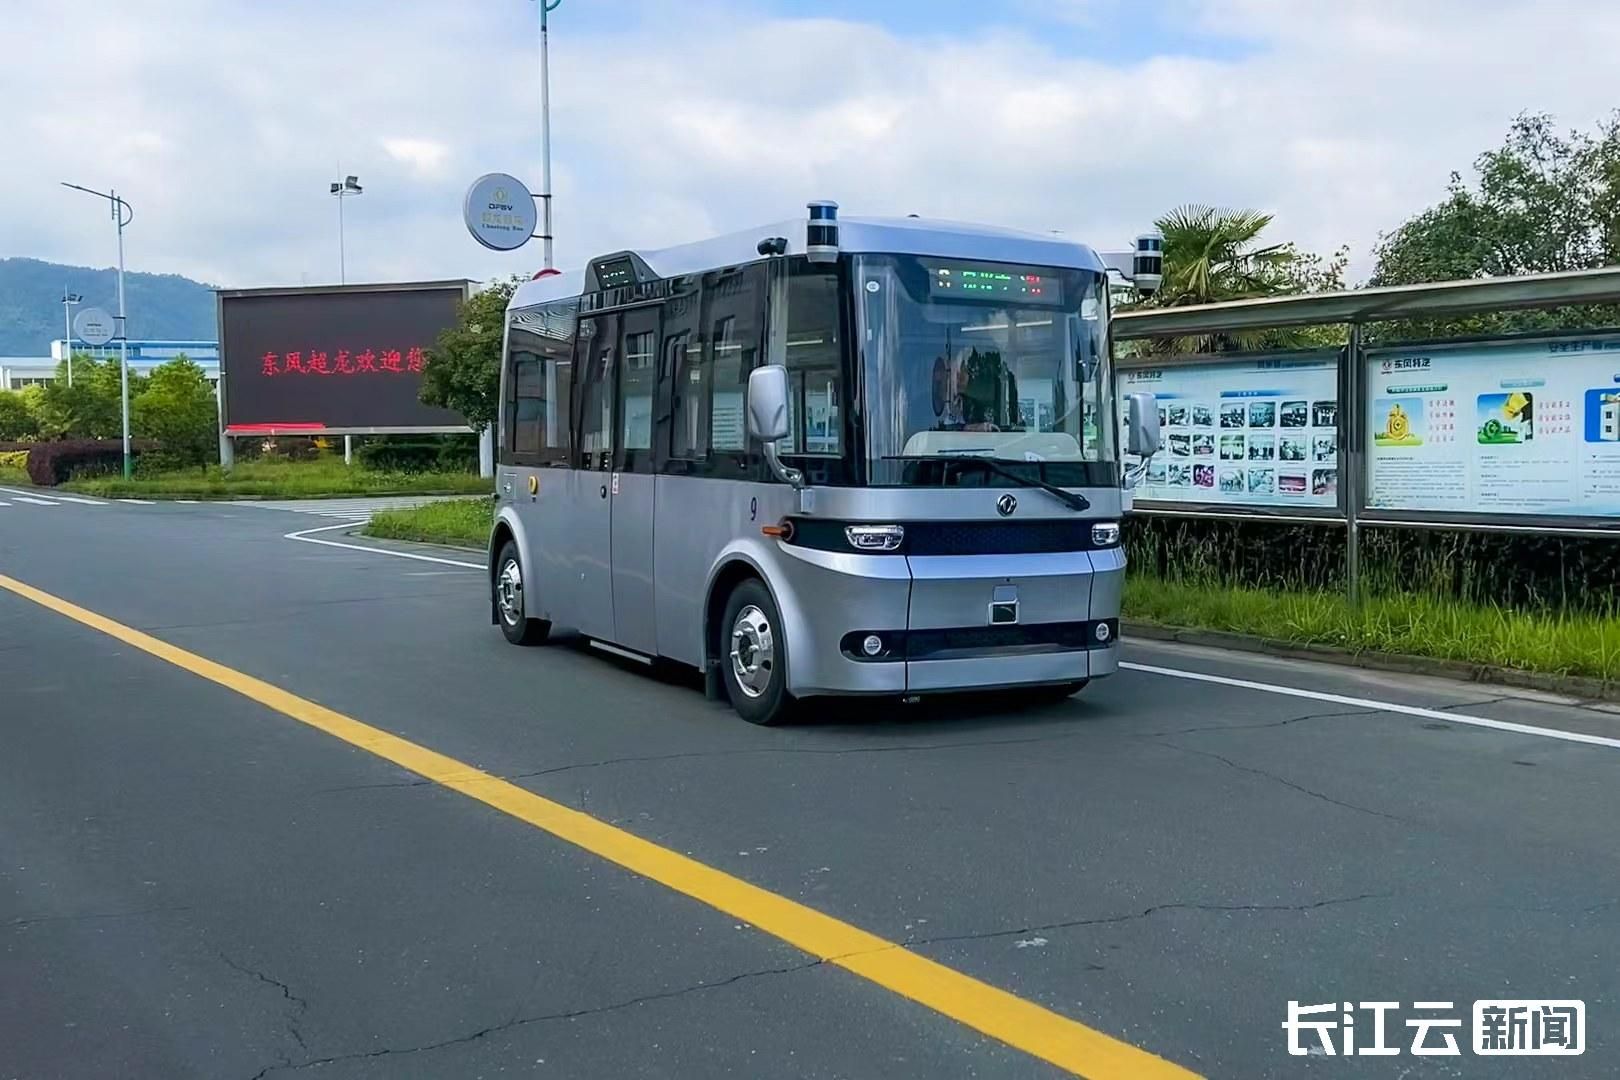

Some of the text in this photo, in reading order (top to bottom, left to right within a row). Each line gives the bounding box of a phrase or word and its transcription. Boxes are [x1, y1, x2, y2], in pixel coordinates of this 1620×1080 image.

[261, 347, 424, 376] 东风超龙欢迎您
[750, 496, 757, 521] 9
